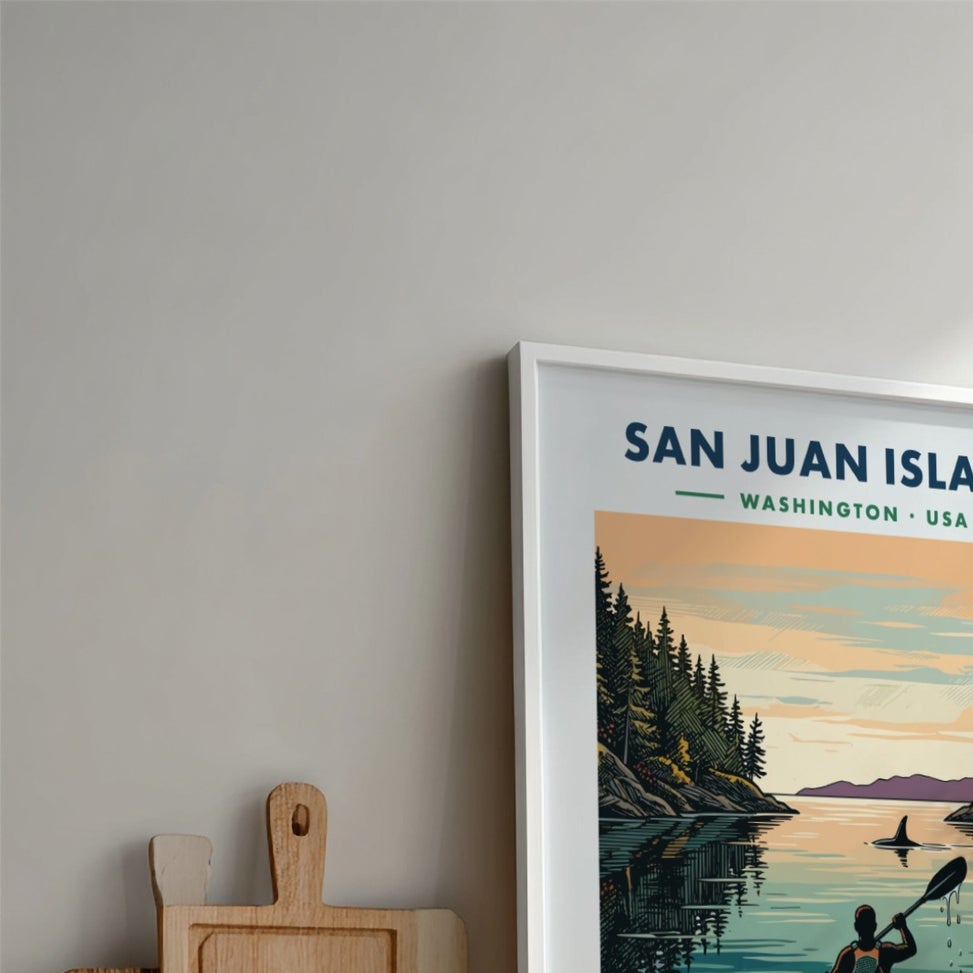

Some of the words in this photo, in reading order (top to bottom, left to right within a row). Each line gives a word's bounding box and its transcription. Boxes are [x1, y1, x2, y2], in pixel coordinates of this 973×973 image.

[624, 421, 724, 469] SAN
[740, 434, 868, 483] JUAN
[739, 492, 898, 522] WASHINGTON
[926, 509, 968, 529] USA
